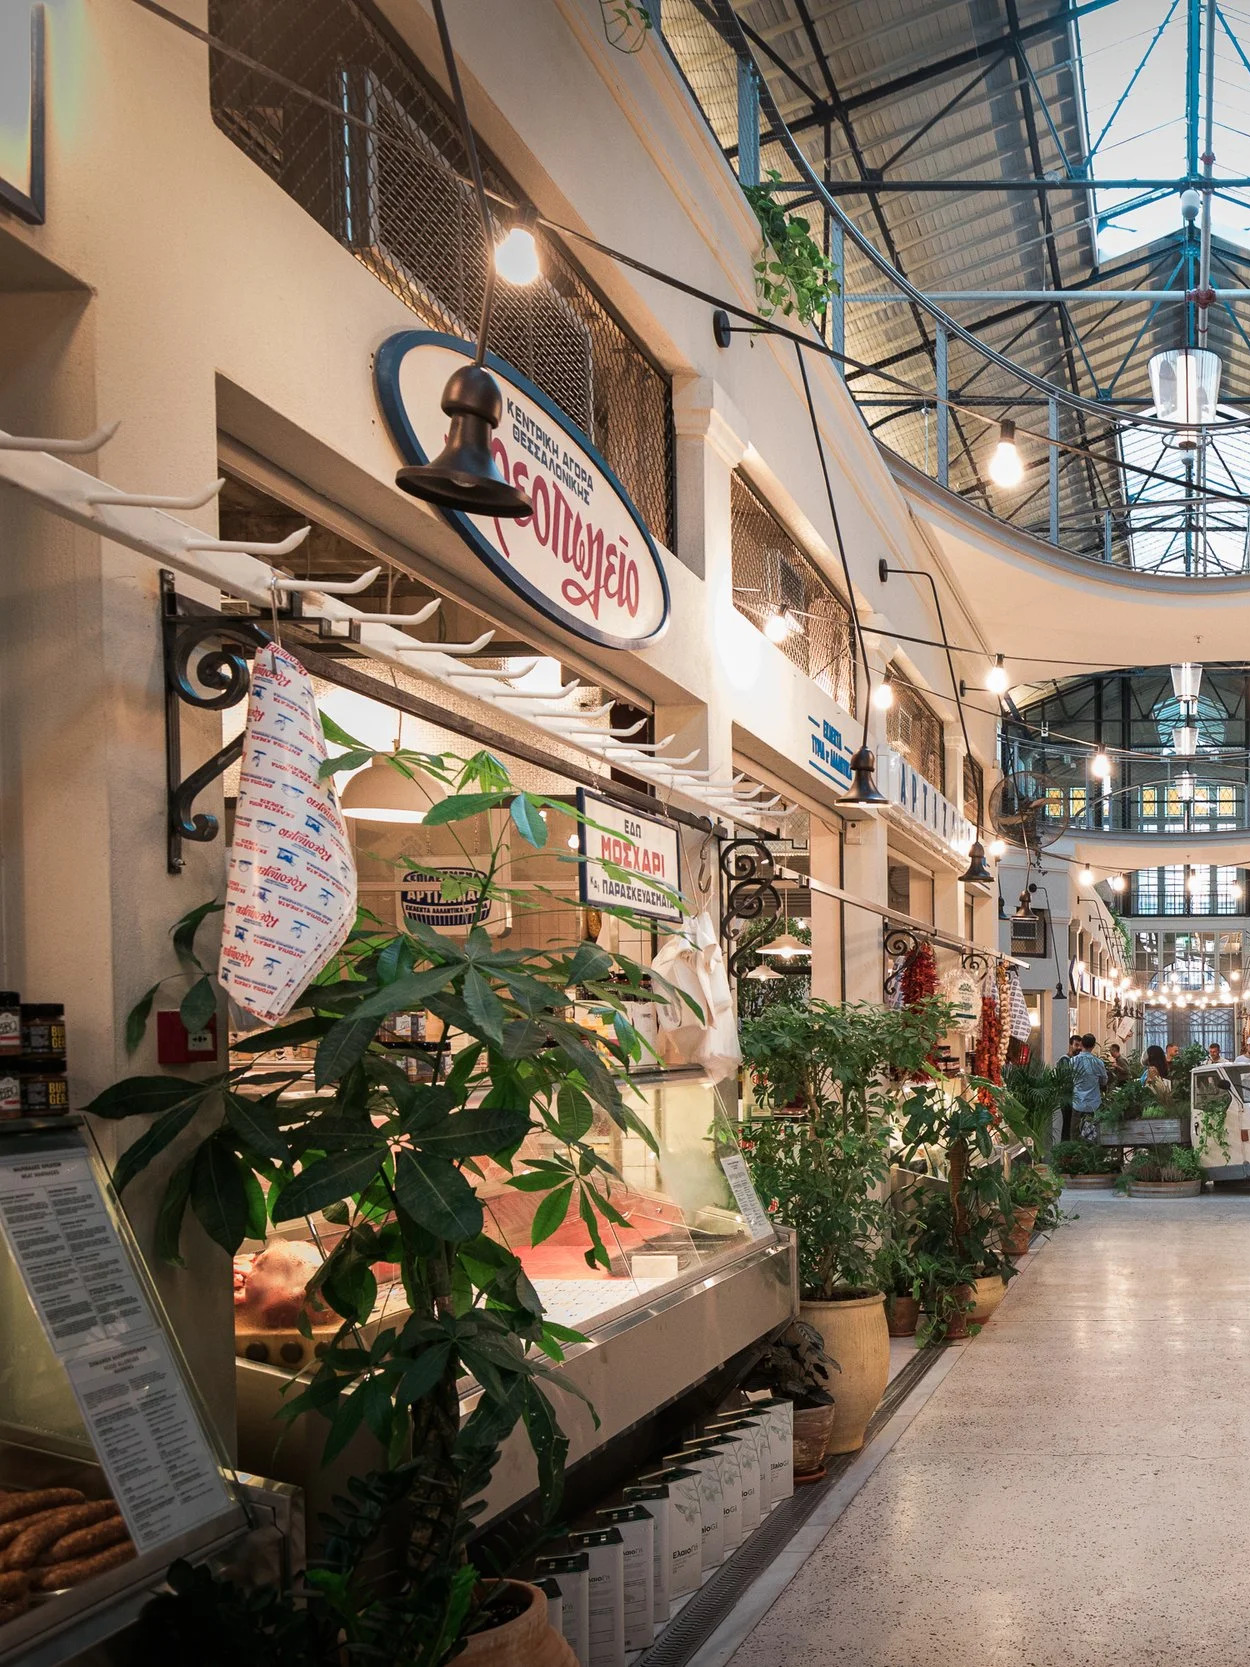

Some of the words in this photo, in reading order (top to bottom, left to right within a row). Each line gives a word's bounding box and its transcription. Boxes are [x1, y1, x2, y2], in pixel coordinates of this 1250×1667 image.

[506, 397, 559, 458] ΚΕΝΤΡΙΚΗ
[562, 453, 594, 492] ΑΓΟΡΑ
[512, 425, 591, 506] ΘΕΣΣΑΛΟΝΙΚΗΣ
[444, 434, 640, 620] ρεοπωλείο
[601, 834, 665, 878] ΜΟΣΧΑΡΙ
[624, 819, 642, 839] ΕΔΩ
